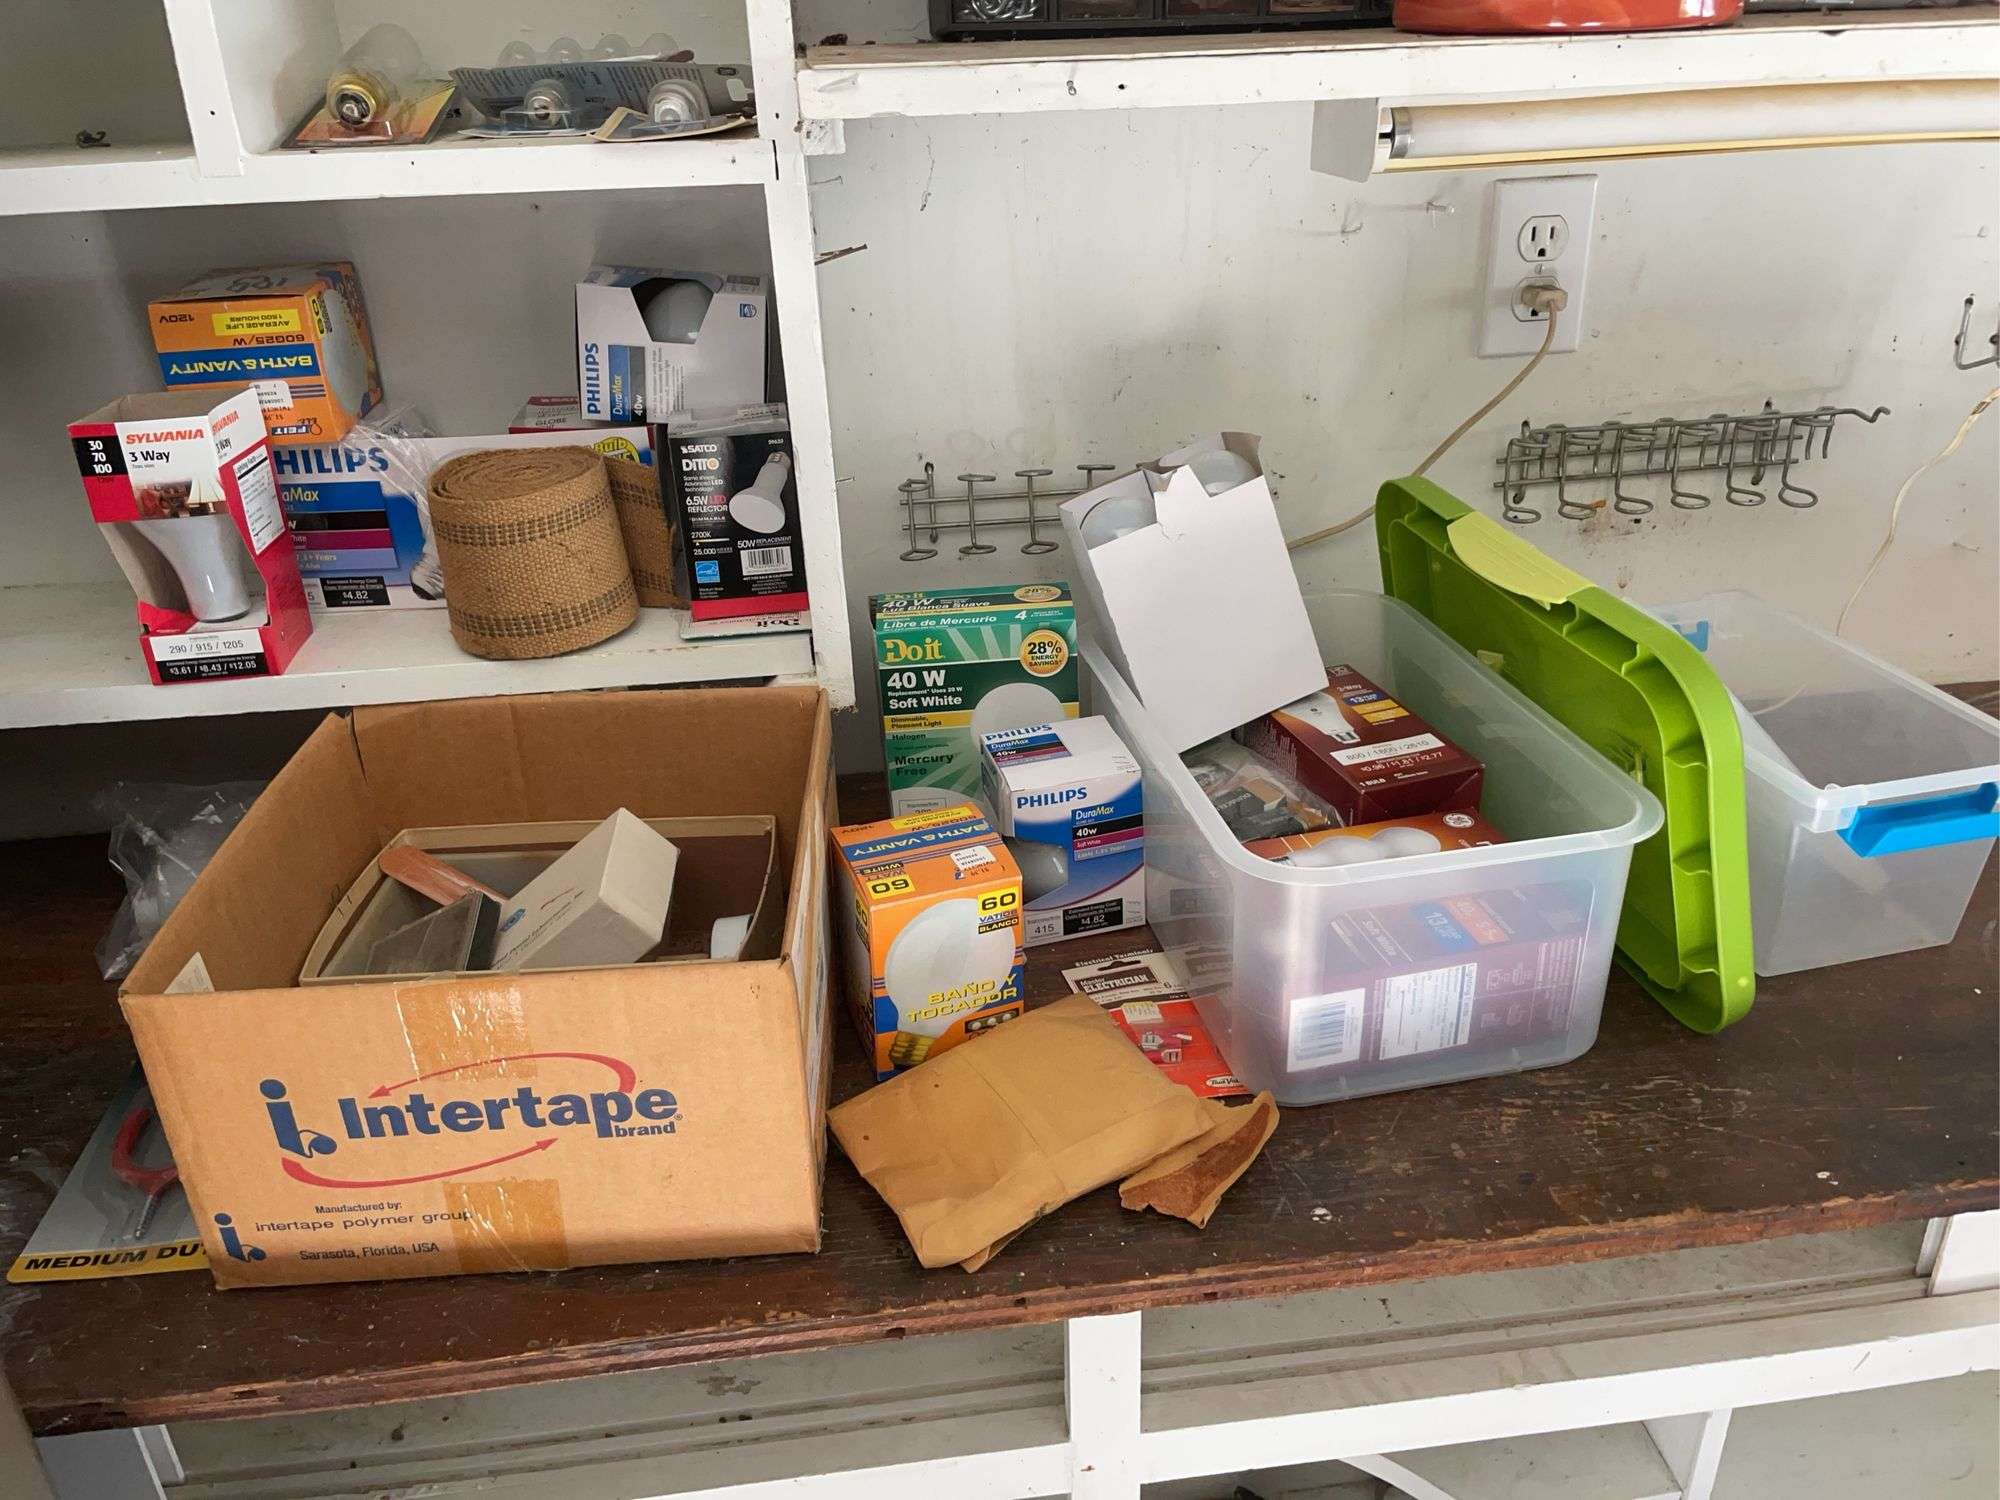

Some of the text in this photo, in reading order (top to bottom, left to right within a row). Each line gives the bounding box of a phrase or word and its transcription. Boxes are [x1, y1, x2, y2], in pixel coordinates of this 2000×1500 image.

[159, 313, 195, 324] 120V
[243, 320, 290, 328] AVERAGE
[232, 334, 305, 347] 60G25/W
[169, 355, 313, 375] BATH & VANITY
[584, 342, 602, 415] PHILIPS
[612, 374, 624, 416] DuraMax
[632, 394, 645, 416] 40w
[211, 410, 240, 434] SYLVANIA
[126, 428, 205, 445] SYLVANIA
[273, 425, 310, 436] FEIT
[88, 440, 104, 451] 30
[687, 444, 717, 453] SATCO
[92, 452, 107, 463] 70
[129, 450, 171, 464] 3 Way
[272, 447, 390, 475] HILIPS
[93, 463, 113, 475] 100
[682, 457, 720, 472] DITTO
[686, 495, 709, 506] 6.5W
[687, 504, 728, 513] REFLECTOR
[691, 531, 712, 539] 2700K
[737, 539, 756, 549] 50W
[342, 590, 369, 601] $4.82
[882, 600, 908, 608] 40
[911, 598, 936, 608] W
[882, 606, 906, 614] Luz
[883, 620, 918, 630] Libre
[920, 619, 937, 627] de
[940, 614, 997, 626] Mercurio
[1014, 610, 1028, 621] 4
[169, 645, 187, 655] 290
[195, 642, 213, 652] 915
[222, 640, 244, 650] 1205
[1027, 640, 1062, 655] 28%
[1030, 654, 1060, 662] ENERGY
[170, 666, 192, 676] $3.61
[229, 661, 257, 671] $12.05
[886, 669, 946, 689] 40 W
[931, 687, 947, 695] Uses
[888, 695, 963, 710] Soft White
[923, 719, 943, 728] Light
[891, 732, 927, 741] Halogen
[985, 724, 1053, 742] PHILIPS
[991, 739, 1030, 750] DuraMax
[895, 753, 955, 767] Mercury
[895, 766, 928, 778] Free
[1366, 778, 1387, 787] BULB
[1016, 787, 1088, 810] PHILIPS
[1075, 806, 1115, 821] DuraMax
[1076, 827, 1098, 837] 40w
[853, 823, 991, 857] BATH & VANITY
[1076, 840, 1087, 848] Soft
[863, 862, 902, 874] WHITE
[871, 878, 910, 895] 60
[981, 892, 1017, 911] 60
[978, 918, 1019, 933] BLANCO
[1081, 914, 1105, 926] $4.82
[1034, 923, 1055, 934] 415
[1074, 948, 1154, 968] Electrical Terminals
[1080, 976, 1106, 988] Master
[1083, 973, 1151, 994] ELECTRICIAN
[927, 973, 1018, 1006] BAÑO Y
[906, 987, 1018, 1023] TOCADOR
[338, 1087, 679, 1140] Intertape
[614, 1121, 676, 1138] brand
[314, 1201, 402, 1214] Manufactured by:
[255, 1209, 474, 1234] intertape polymer group
[299, 1242, 440, 1262] Sarasota, Florida, USA
[24, 1250, 146, 1271] MEDIUM
